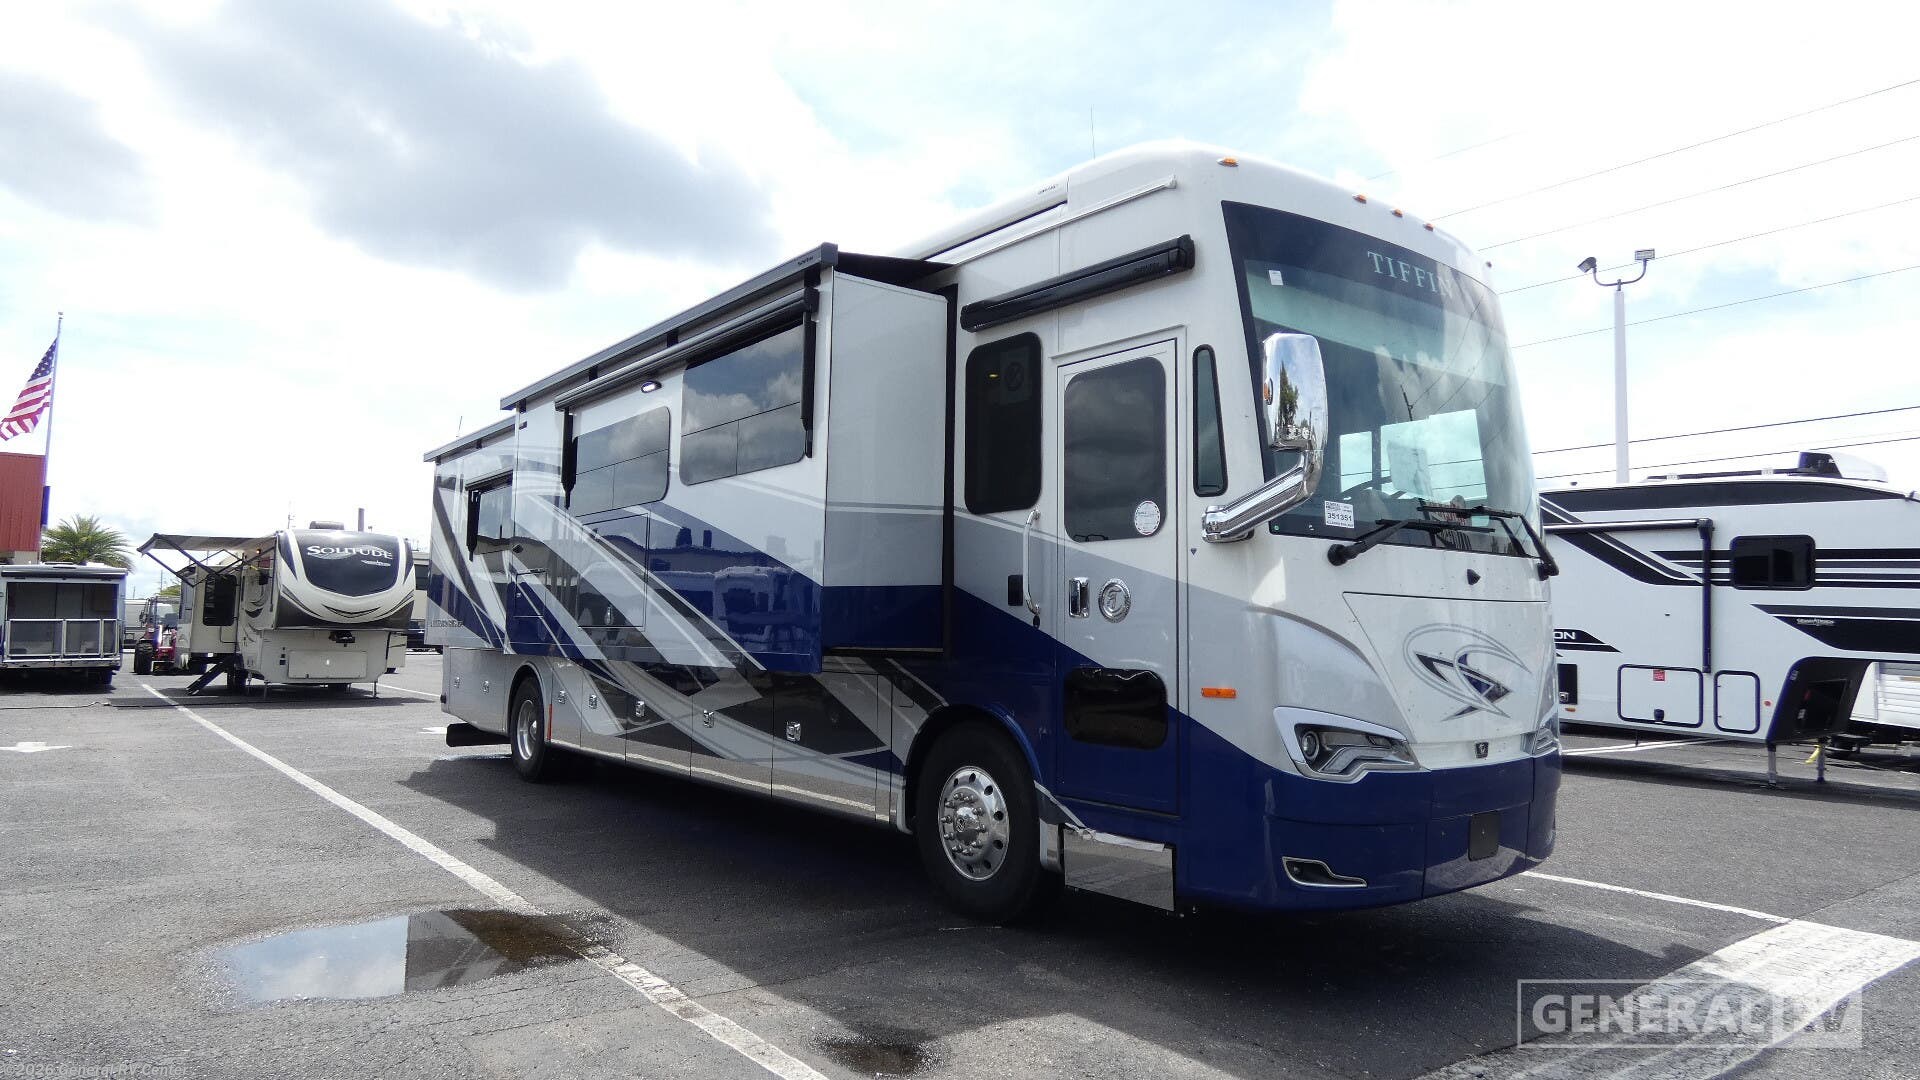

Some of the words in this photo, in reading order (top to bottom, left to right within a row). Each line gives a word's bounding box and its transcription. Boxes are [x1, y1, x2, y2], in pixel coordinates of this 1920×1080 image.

[1367, 250, 1453, 299] TIFFIN
[306, 545, 393, 560] SOLITUDE
[1553, 631, 1576, 639] ON
